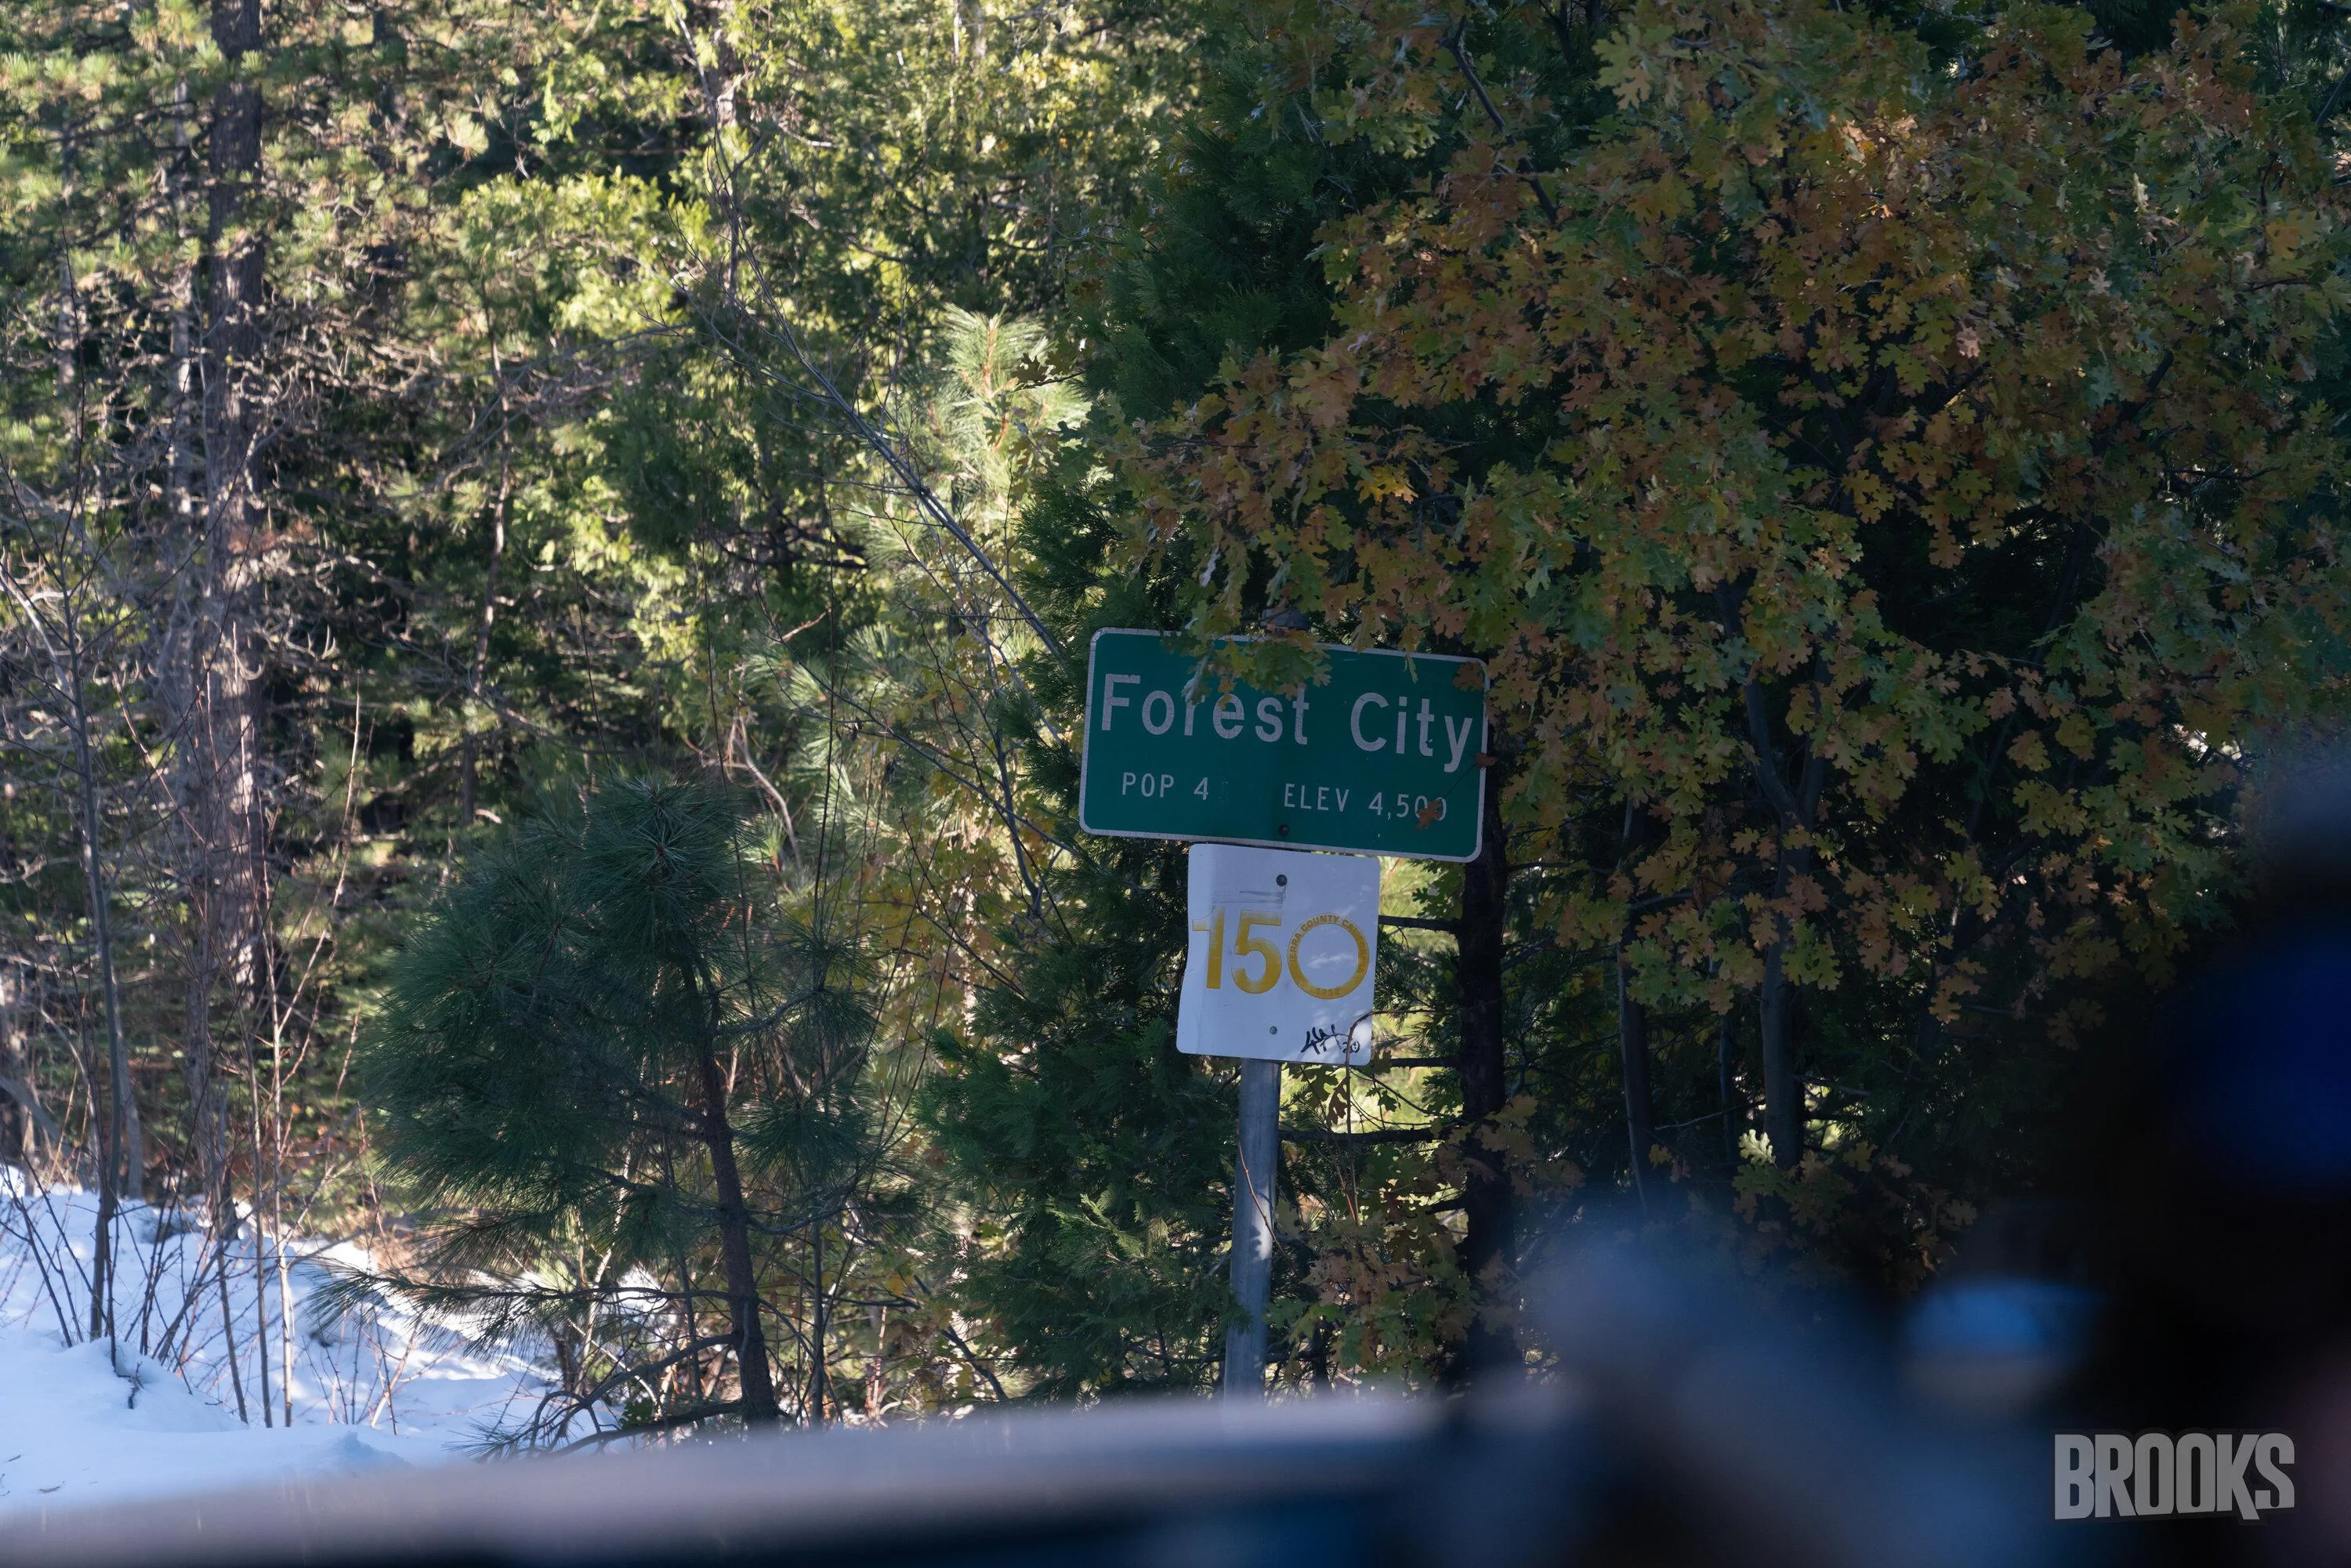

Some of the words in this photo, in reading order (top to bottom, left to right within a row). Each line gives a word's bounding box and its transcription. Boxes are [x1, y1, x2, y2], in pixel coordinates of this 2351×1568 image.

[1101, 674, 1310, 745] Forest
[1350, 693, 1473, 773] City
[1121, 772, 1175, 798] POP
[1194, 777, 1209, 801] 4
[1284, 783, 1349, 813] ELEV
[1368, 791, 1447, 821] 4,500
[1301, 914, 1340, 932] COUNTY
[1192, 905, 1370, 999] 150
